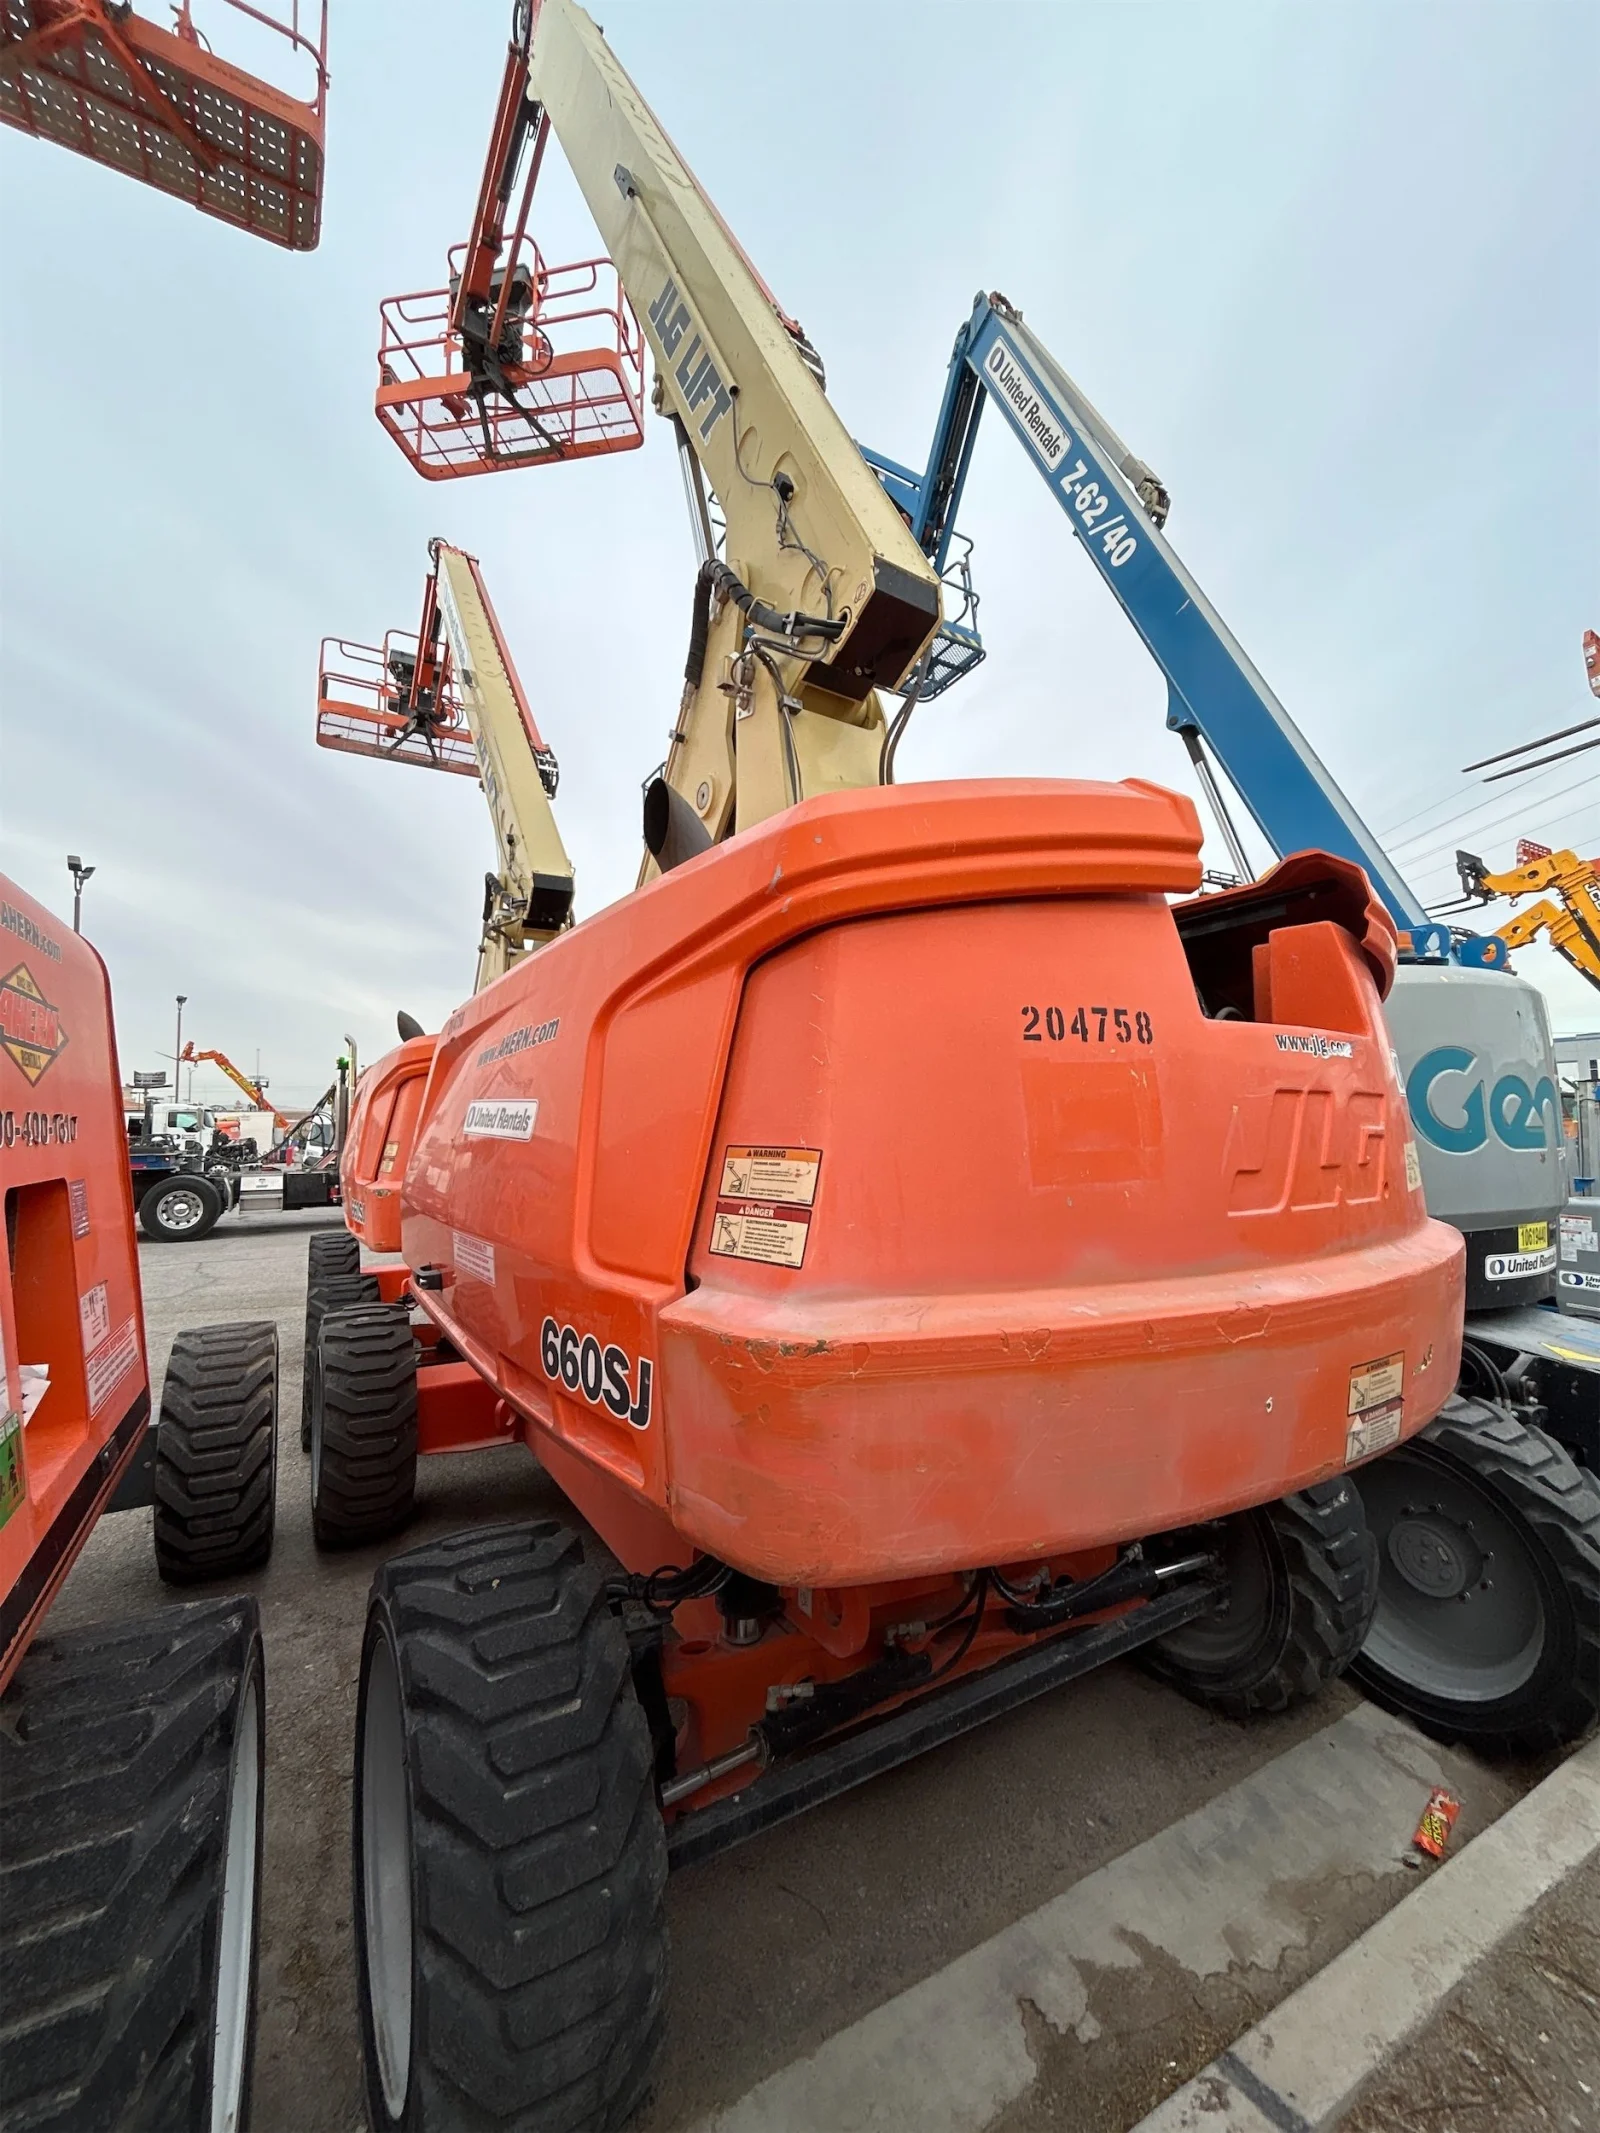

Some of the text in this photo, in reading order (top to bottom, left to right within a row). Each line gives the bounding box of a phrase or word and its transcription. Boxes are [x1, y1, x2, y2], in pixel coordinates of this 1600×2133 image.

[648, 276, 733, 440] JLG LIFT
[999, 361, 1062, 459] United Rentals
[1060, 459, 1137, 567] Z-62/40
[476, 1017, 561, 1068] www.AHERN.com
[1020, 1006, 1153, 1045] 204758
[474, 1106, 531, 1132] United Rentals
[753, 1149, 787, 1159] WARNING
[1227, 1088, 1385, 1218] JLG
[745, 1207, 775, 1218] DANGER
[1507, 1256, 1538, 1273] United
[541, 1315, 654, 1430] 660SJ
